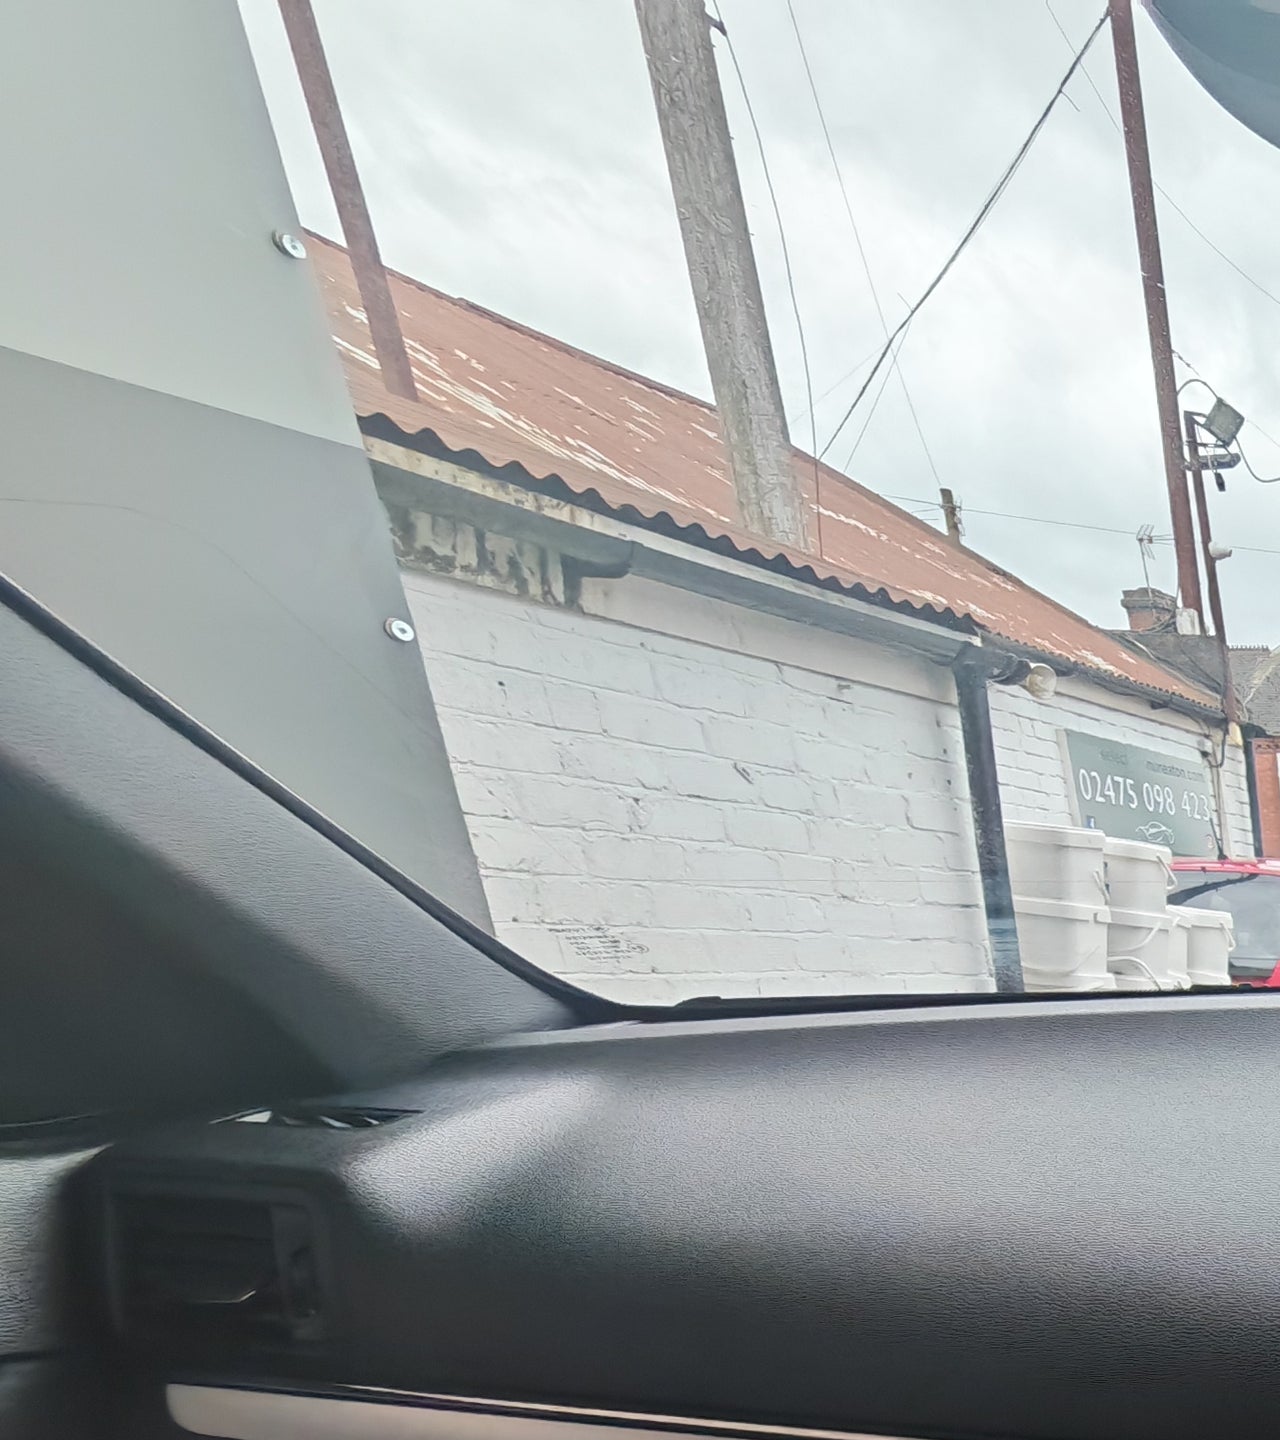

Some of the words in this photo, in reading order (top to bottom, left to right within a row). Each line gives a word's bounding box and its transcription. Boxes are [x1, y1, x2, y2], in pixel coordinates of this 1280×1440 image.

[1078, 768, 1138, 810] 02475
[1142, 782, 1176, 816] 098
[1182, 791, 1211, 821] 423
